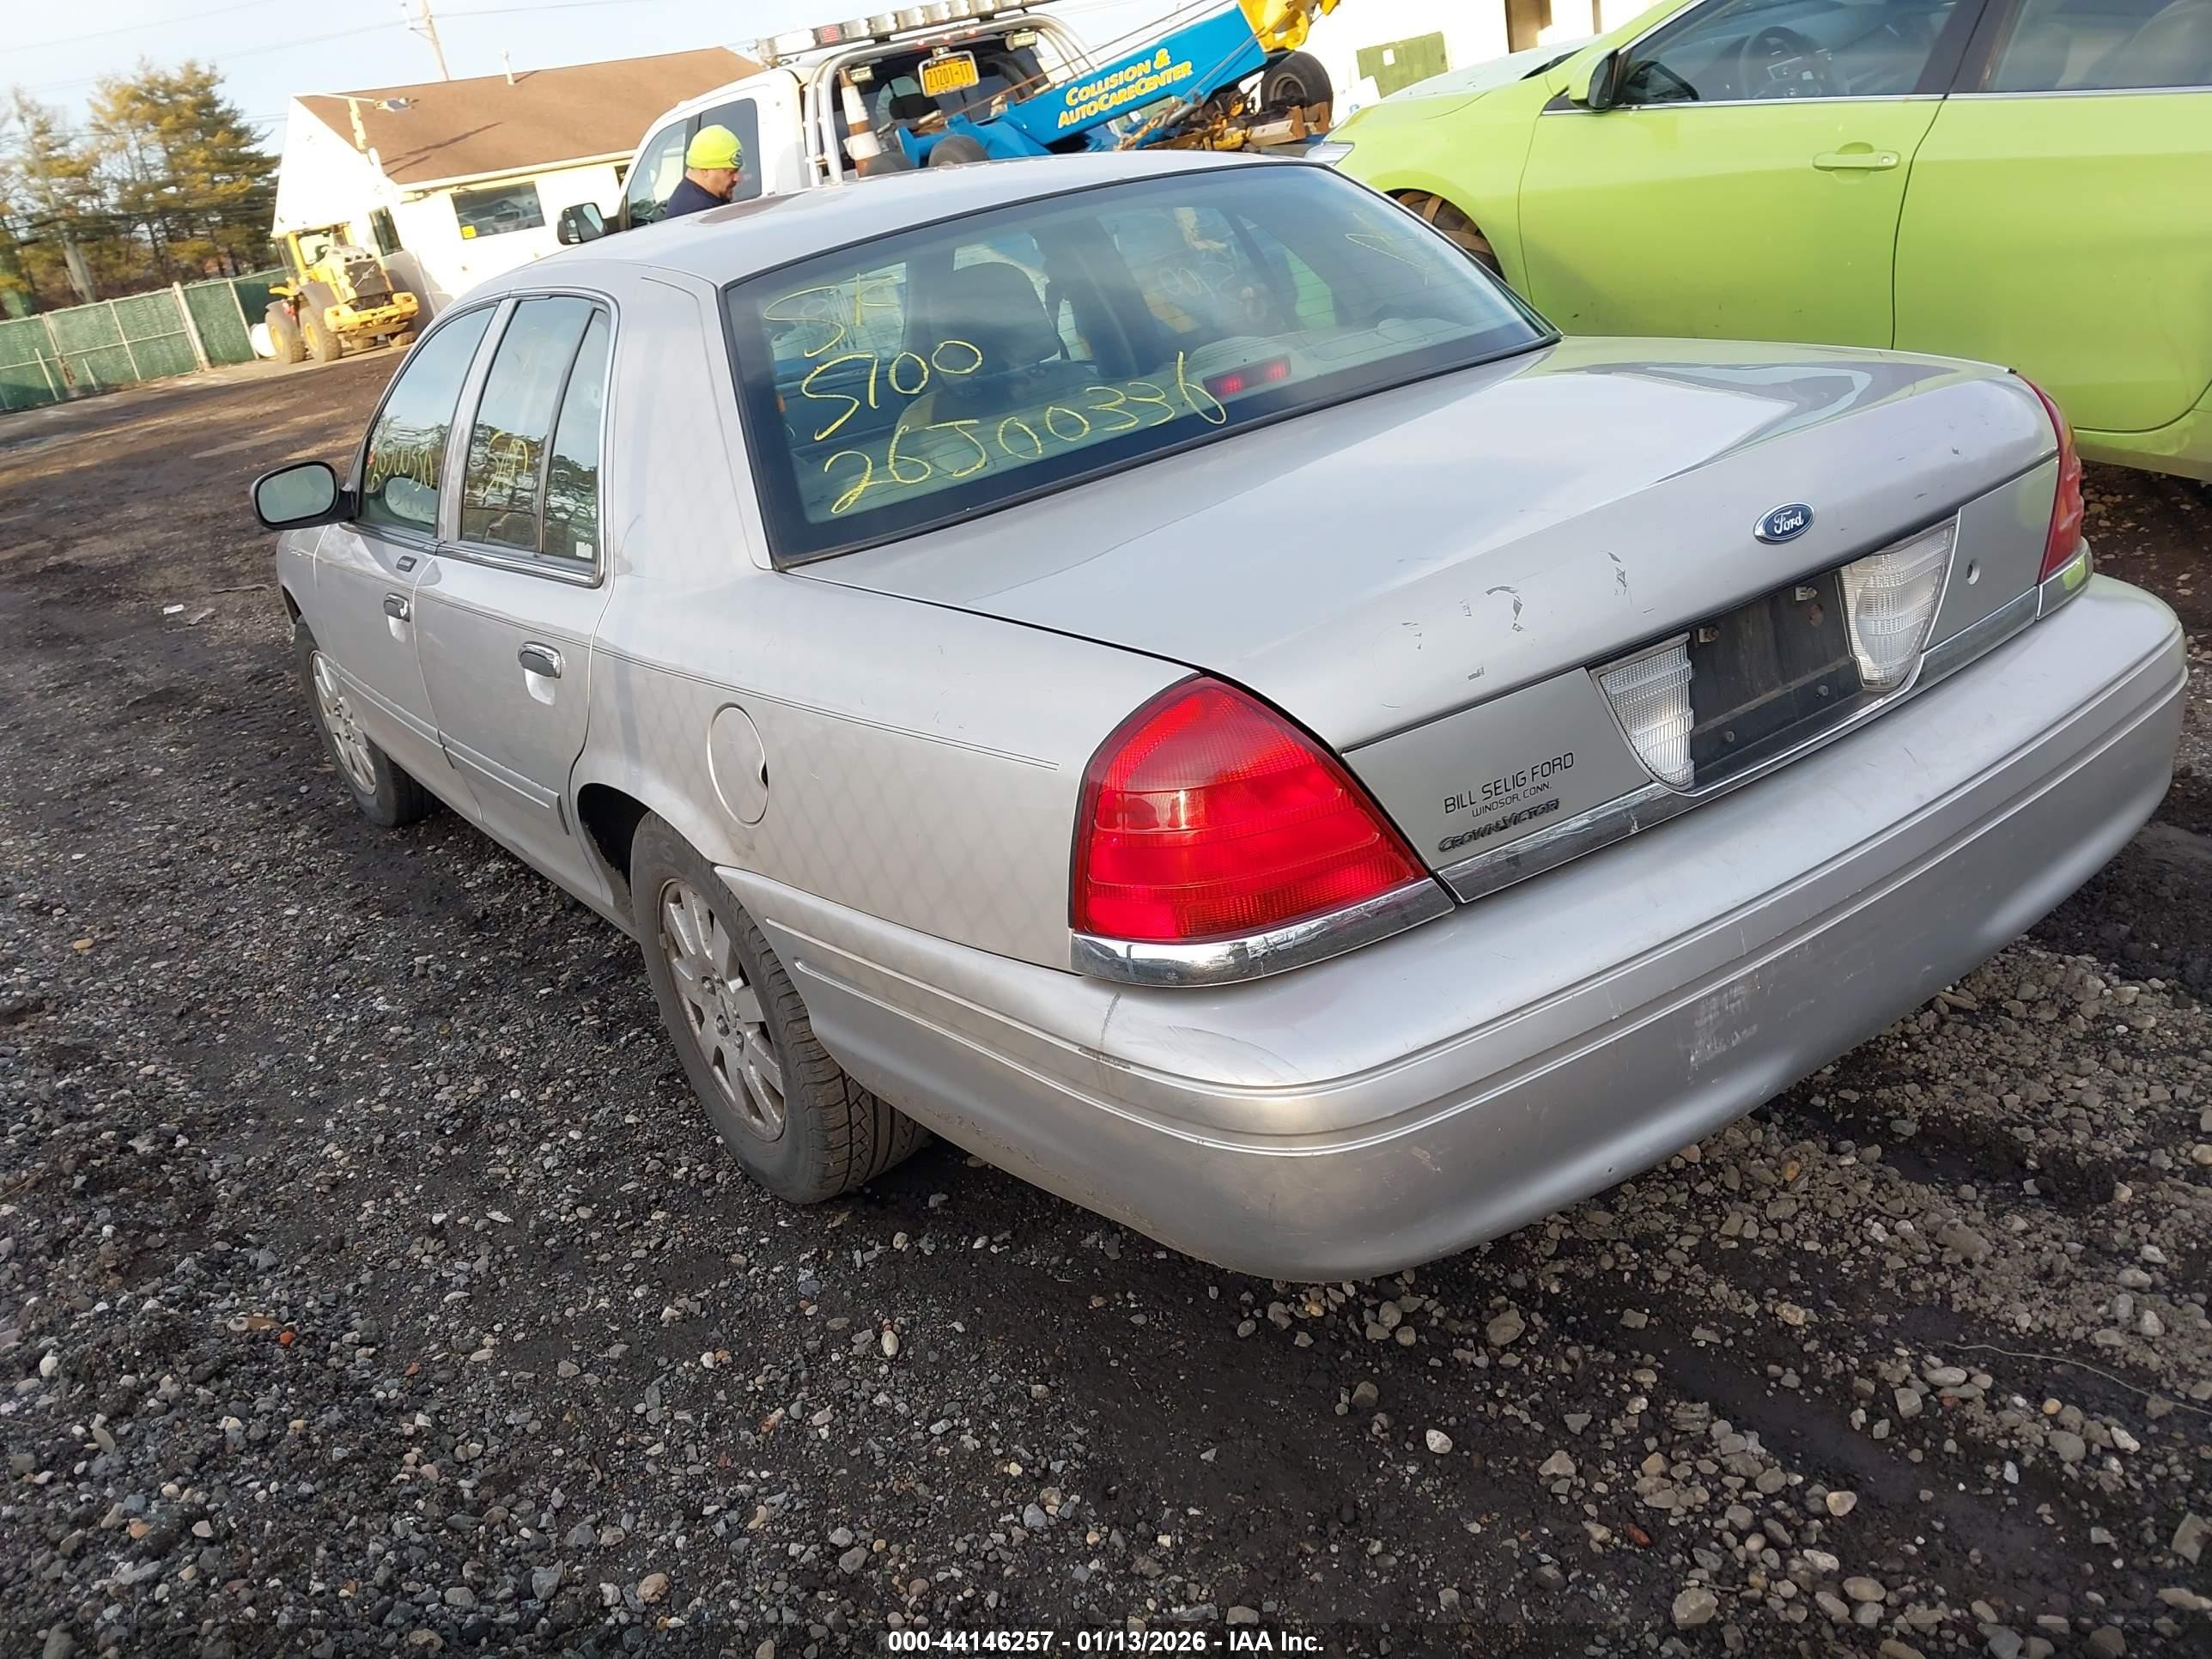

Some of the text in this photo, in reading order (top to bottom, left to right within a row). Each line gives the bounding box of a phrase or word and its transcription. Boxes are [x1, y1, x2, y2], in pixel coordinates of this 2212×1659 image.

[1066, 48, 1171, 106] COLLISION &
[1773, 509, 1805, 535] Ford
[1443, 751, 1575, 814] BILL SELIG FORD
